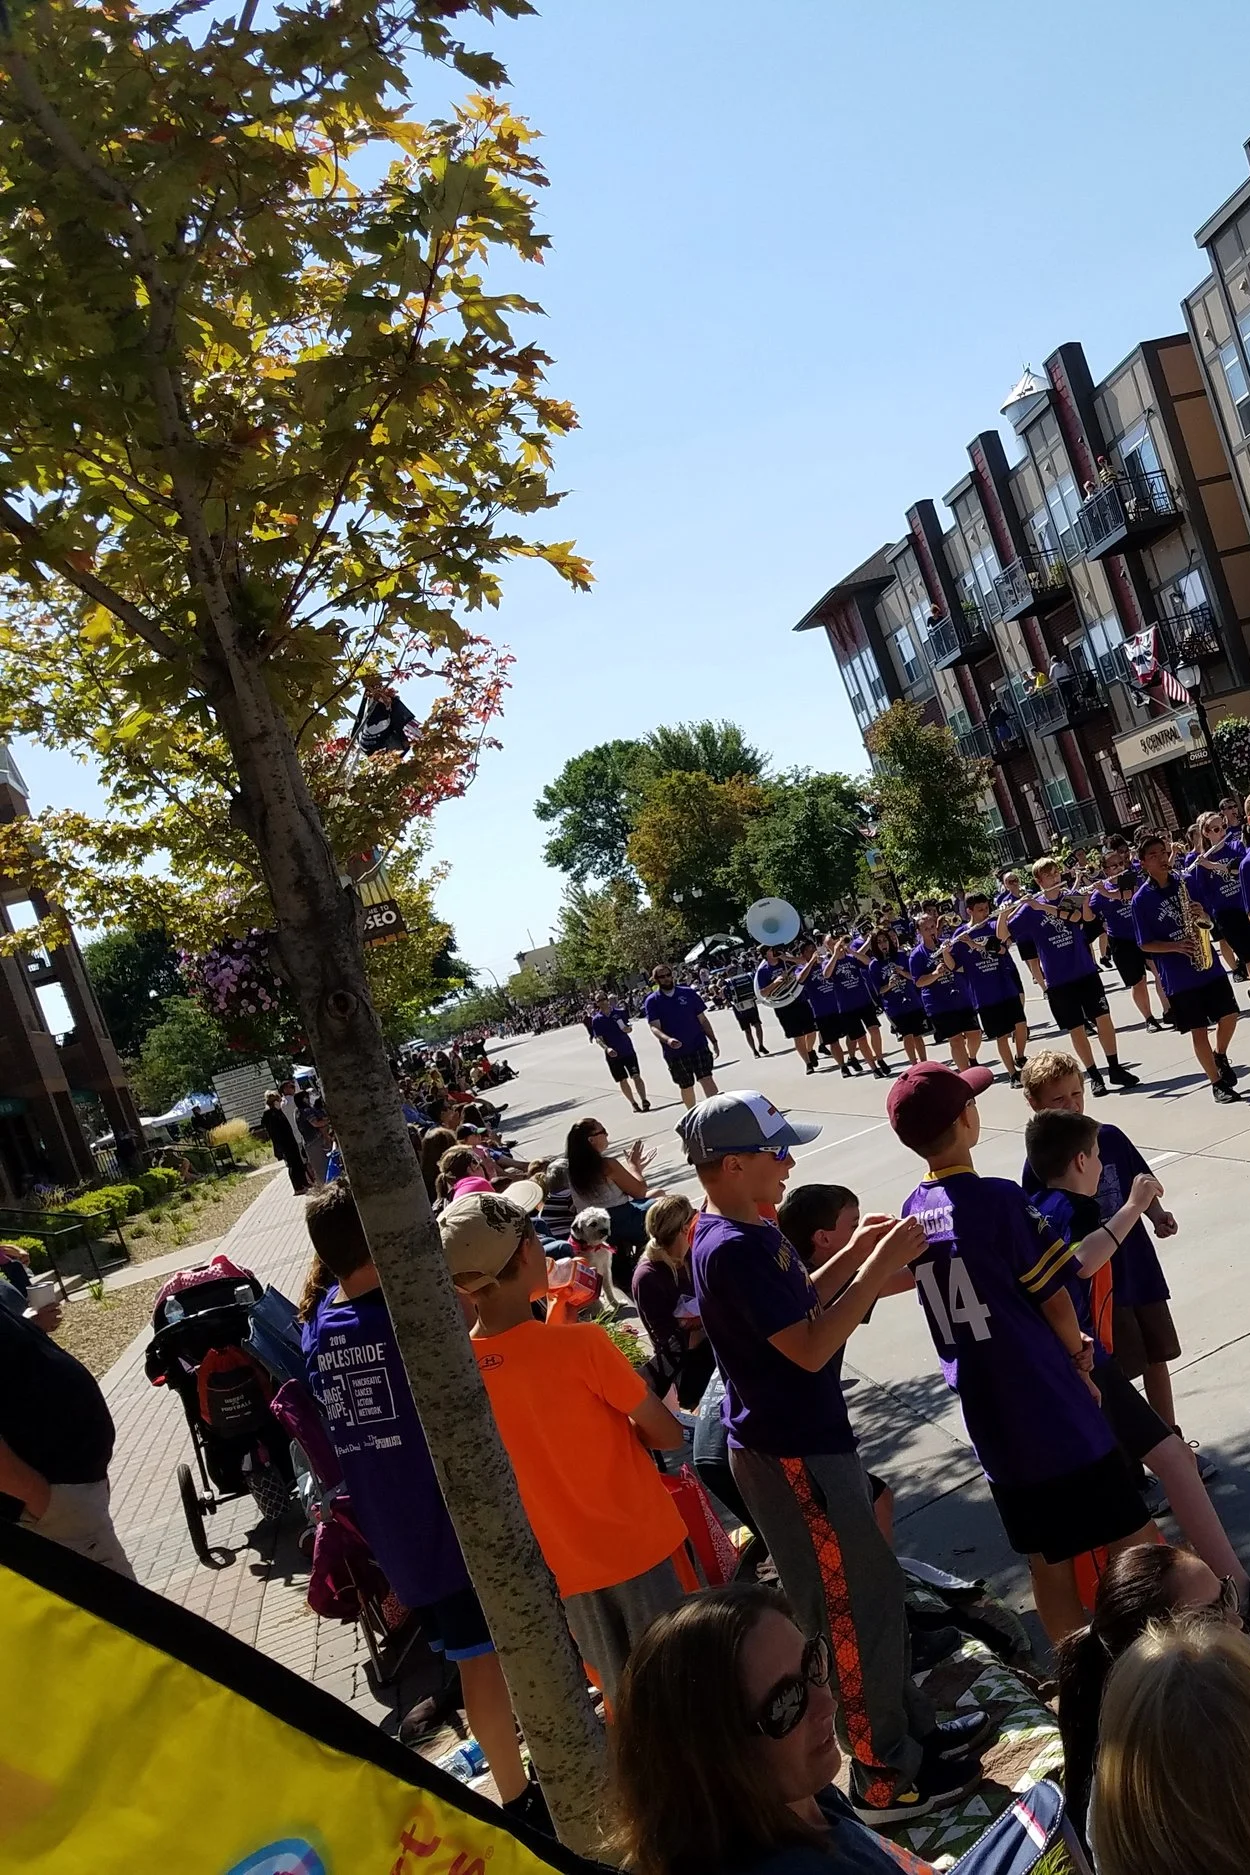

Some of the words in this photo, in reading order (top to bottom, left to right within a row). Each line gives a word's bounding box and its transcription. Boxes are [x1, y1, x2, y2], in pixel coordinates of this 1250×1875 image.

[1146, 725, 1182, 750] CENTRAL
[380, 904, 390, 912] TO
[364, 910, 397, 930] SEO
[917, 1205, 954, 1235] IGGS
[915, 1257, 992, 1344] 14
[329, 1335, 346, 1346] 2016
